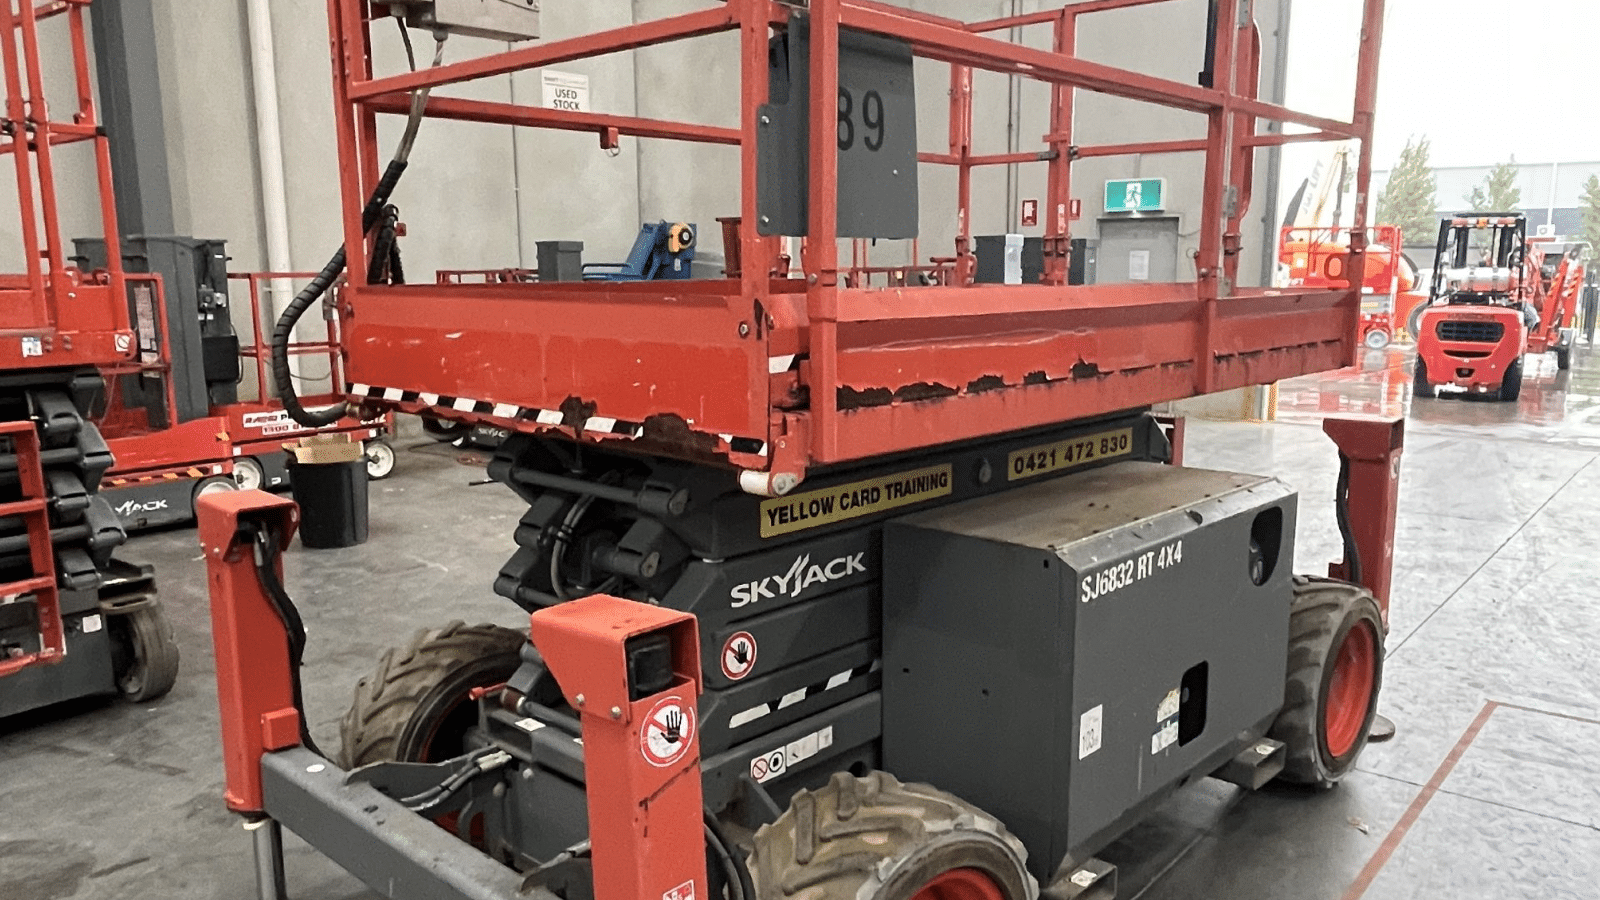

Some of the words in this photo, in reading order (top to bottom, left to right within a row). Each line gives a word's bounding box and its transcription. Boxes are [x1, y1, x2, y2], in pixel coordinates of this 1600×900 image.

[553, 99, 580, 110] STOCK
[555, 88, 577, 99] USED
[1014, 448, 1056, 475] 0421
[1064, 441, 1094, 463] 472
[1100, 434, 1128, 455] 830
[767, 496, 835, 527] YELLOW
[839, 487, 881, 511] CARD
[884, 471, 948, 501] TRAINING
[730, 552, 867, 608] SKYJACK
[1081, 560, 1134, 603] SJ6832
[1137, 551, 1155, 580] RT
[1157, 540, 1183, 570] 4X4
